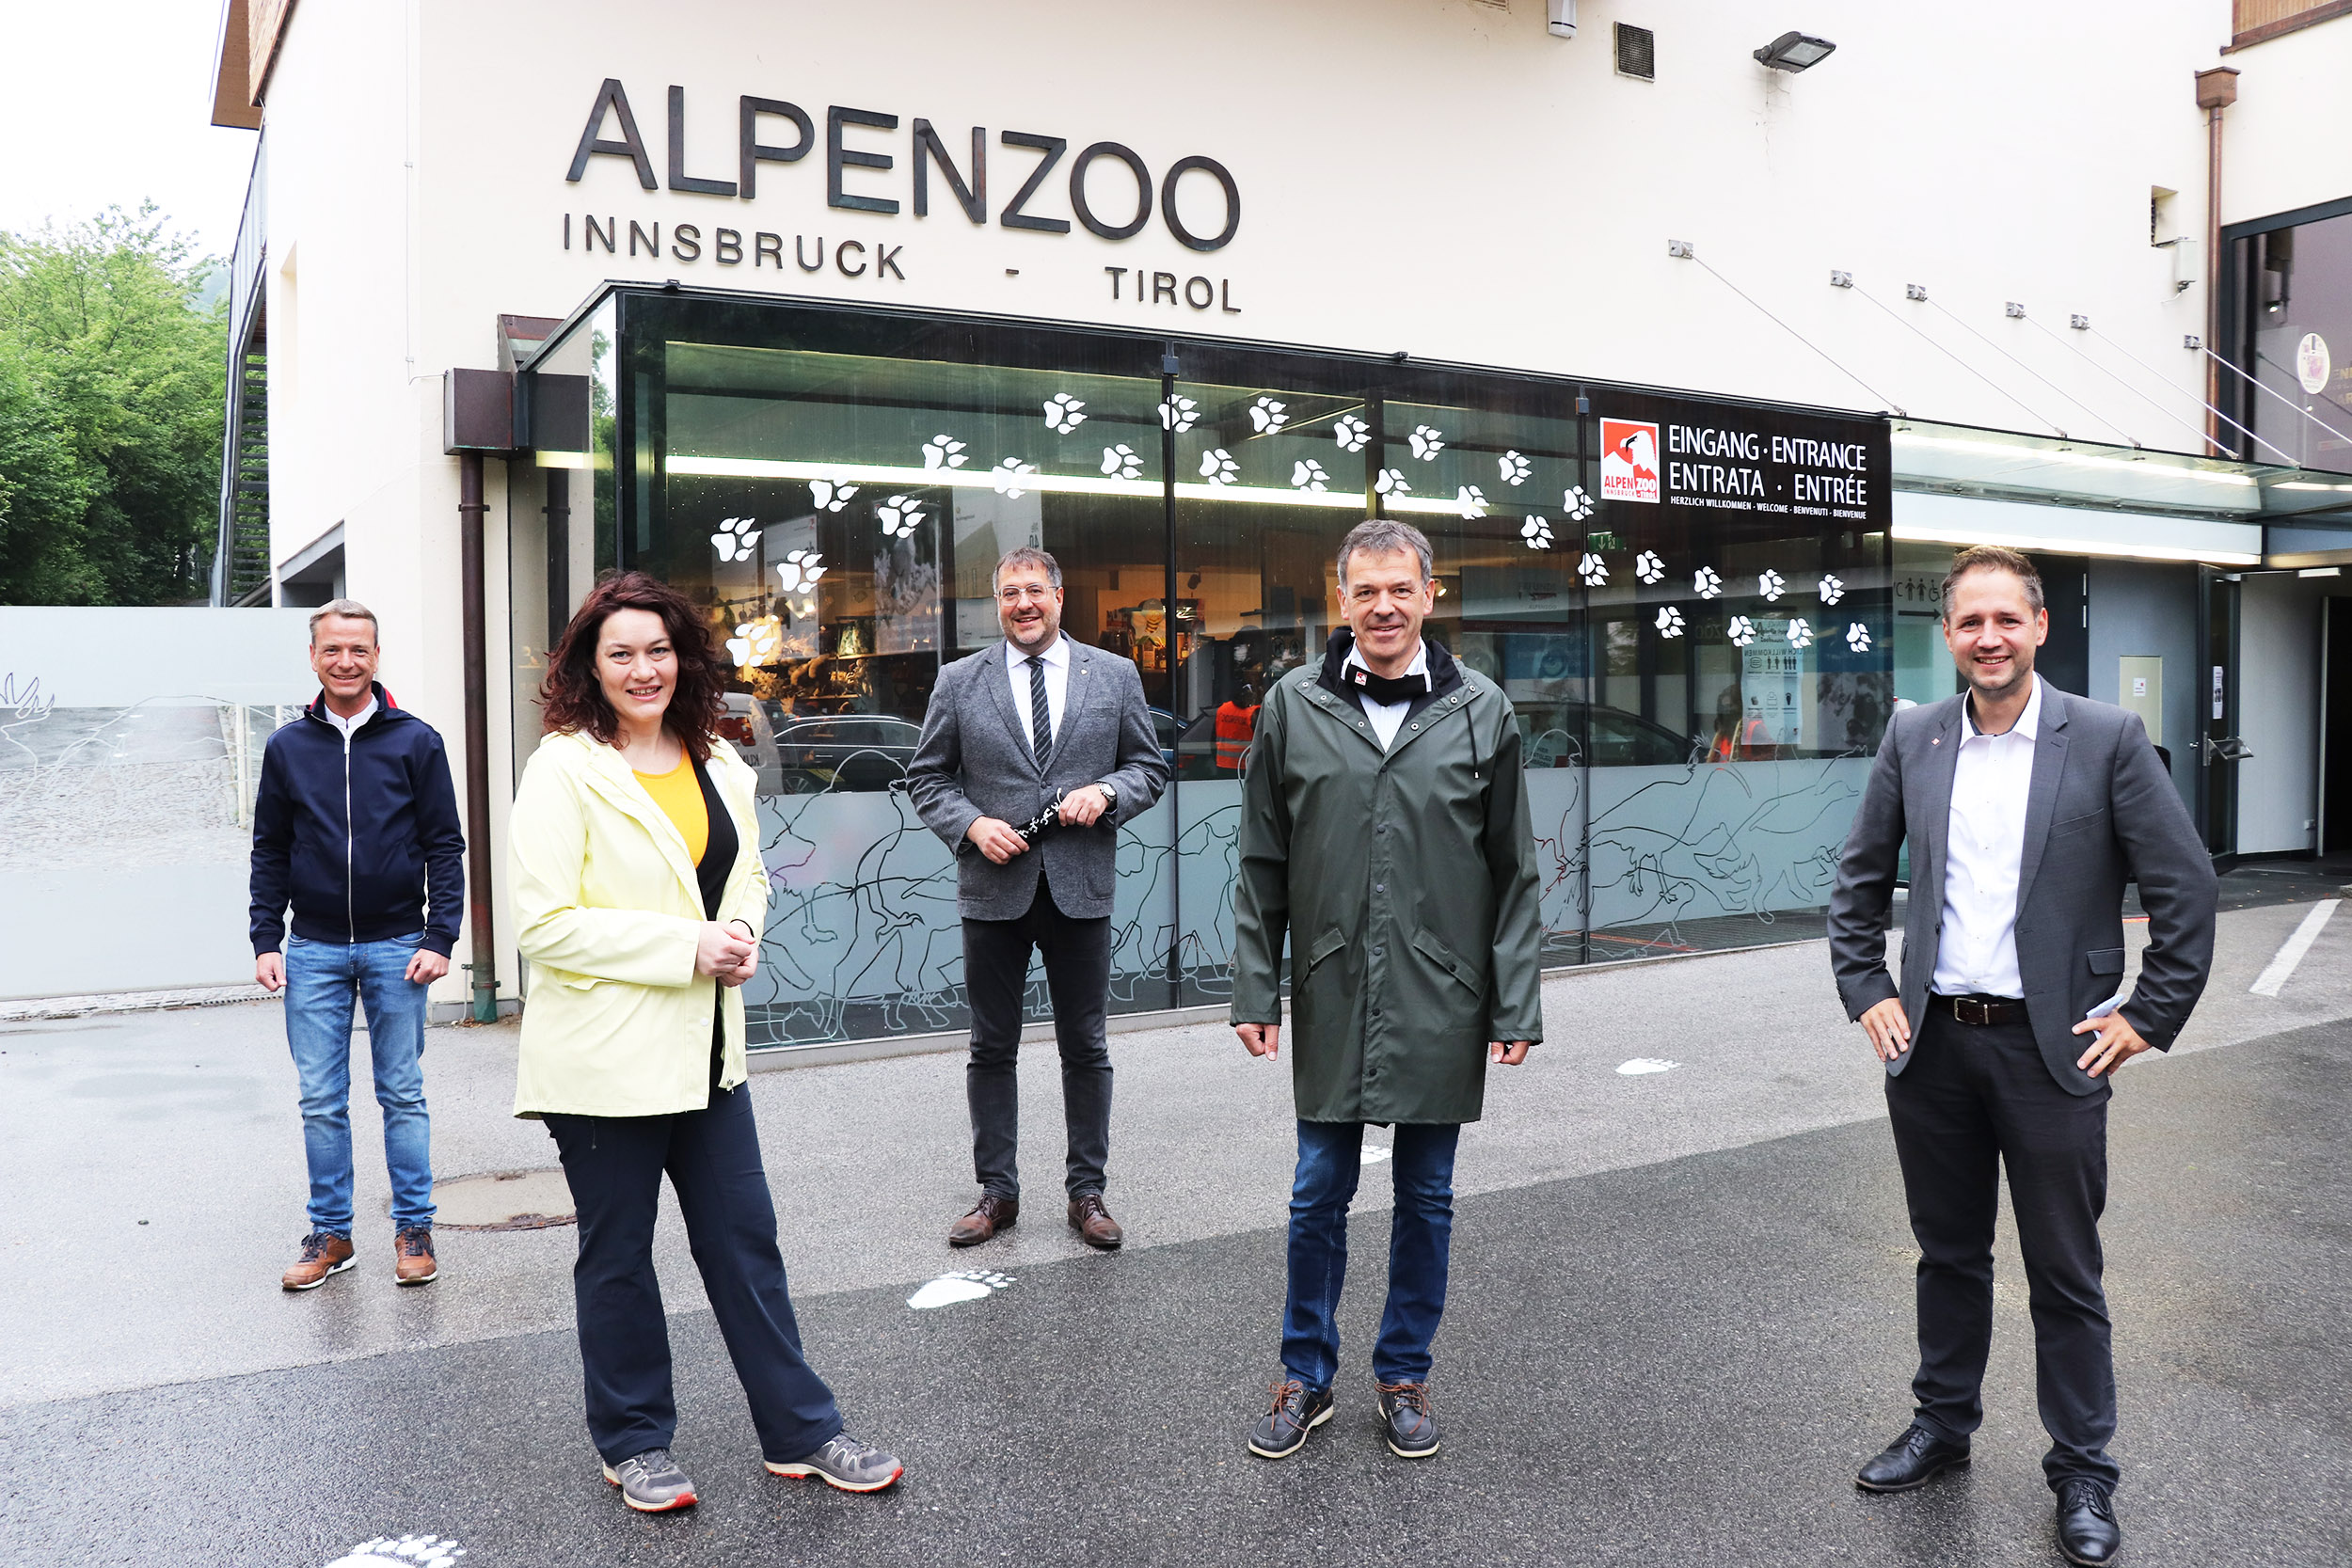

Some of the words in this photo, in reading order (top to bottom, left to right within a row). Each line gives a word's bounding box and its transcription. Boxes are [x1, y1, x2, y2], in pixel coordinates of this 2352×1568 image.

[565, 78, 1241, 251] ALPENZOO
[564, 213, 906, 281] INNSBRUCK
[1105, 266, 1242, 313] TIROL
[1669, 424, 1759, 460] EINGANG
[1772, 436, 1867, 471] ENTRANCE
[1604, 488, 1635, 497] INNSBRUCK
[1669, 462, 1765, 497] ENTRATA
[1794, 473, 1867, 505] ENTRÉE
[1670, 496, 1705, 507] HERZLICH
[1706, 499, 1752, 510] WILLKOMMEN
[1756, 502, 1788, 514] WELCOME
[1793, 506, 1828, 516] BENVENUTI
[1833, 509, 1867, 519] BIENVENUE
